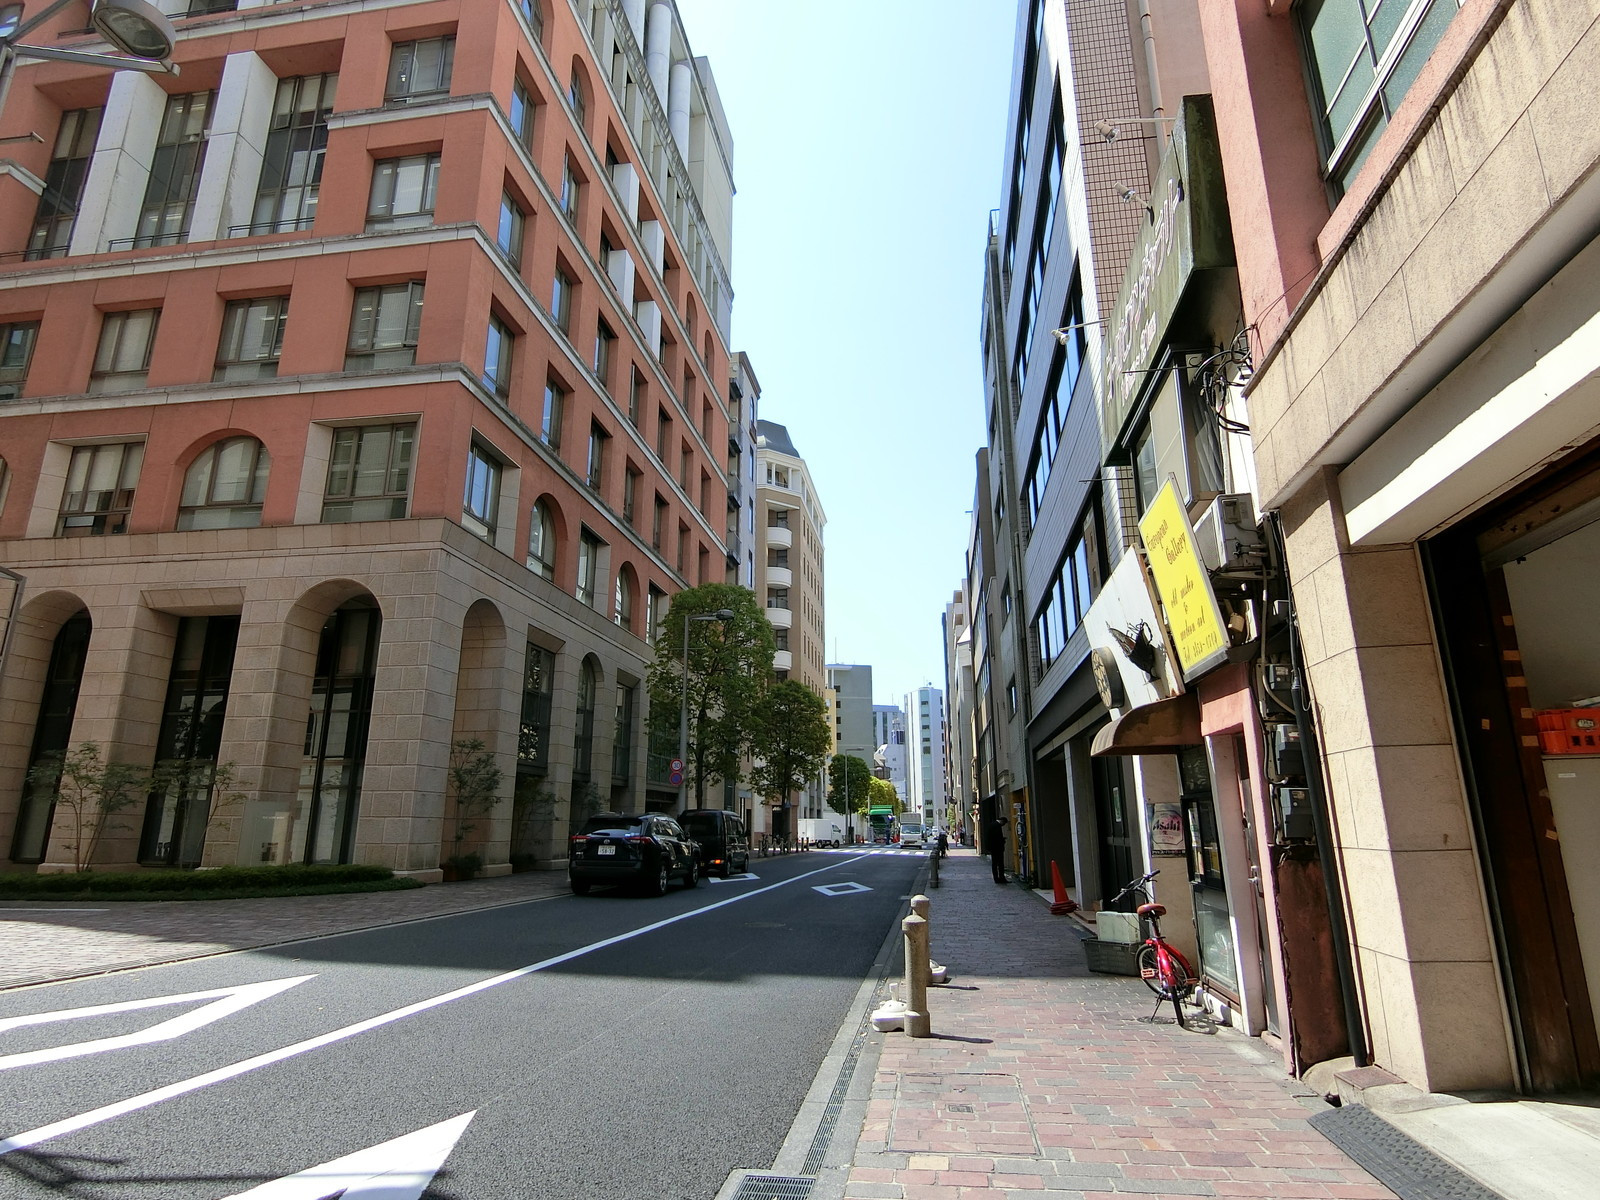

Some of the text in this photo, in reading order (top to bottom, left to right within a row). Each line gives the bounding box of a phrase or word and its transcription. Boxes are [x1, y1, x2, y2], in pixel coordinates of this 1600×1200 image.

[1146, 519, 1168, 551] European
[1166, 532, 1189, 565] Gallery
[1153, 819, 1181, 831] Asahi
